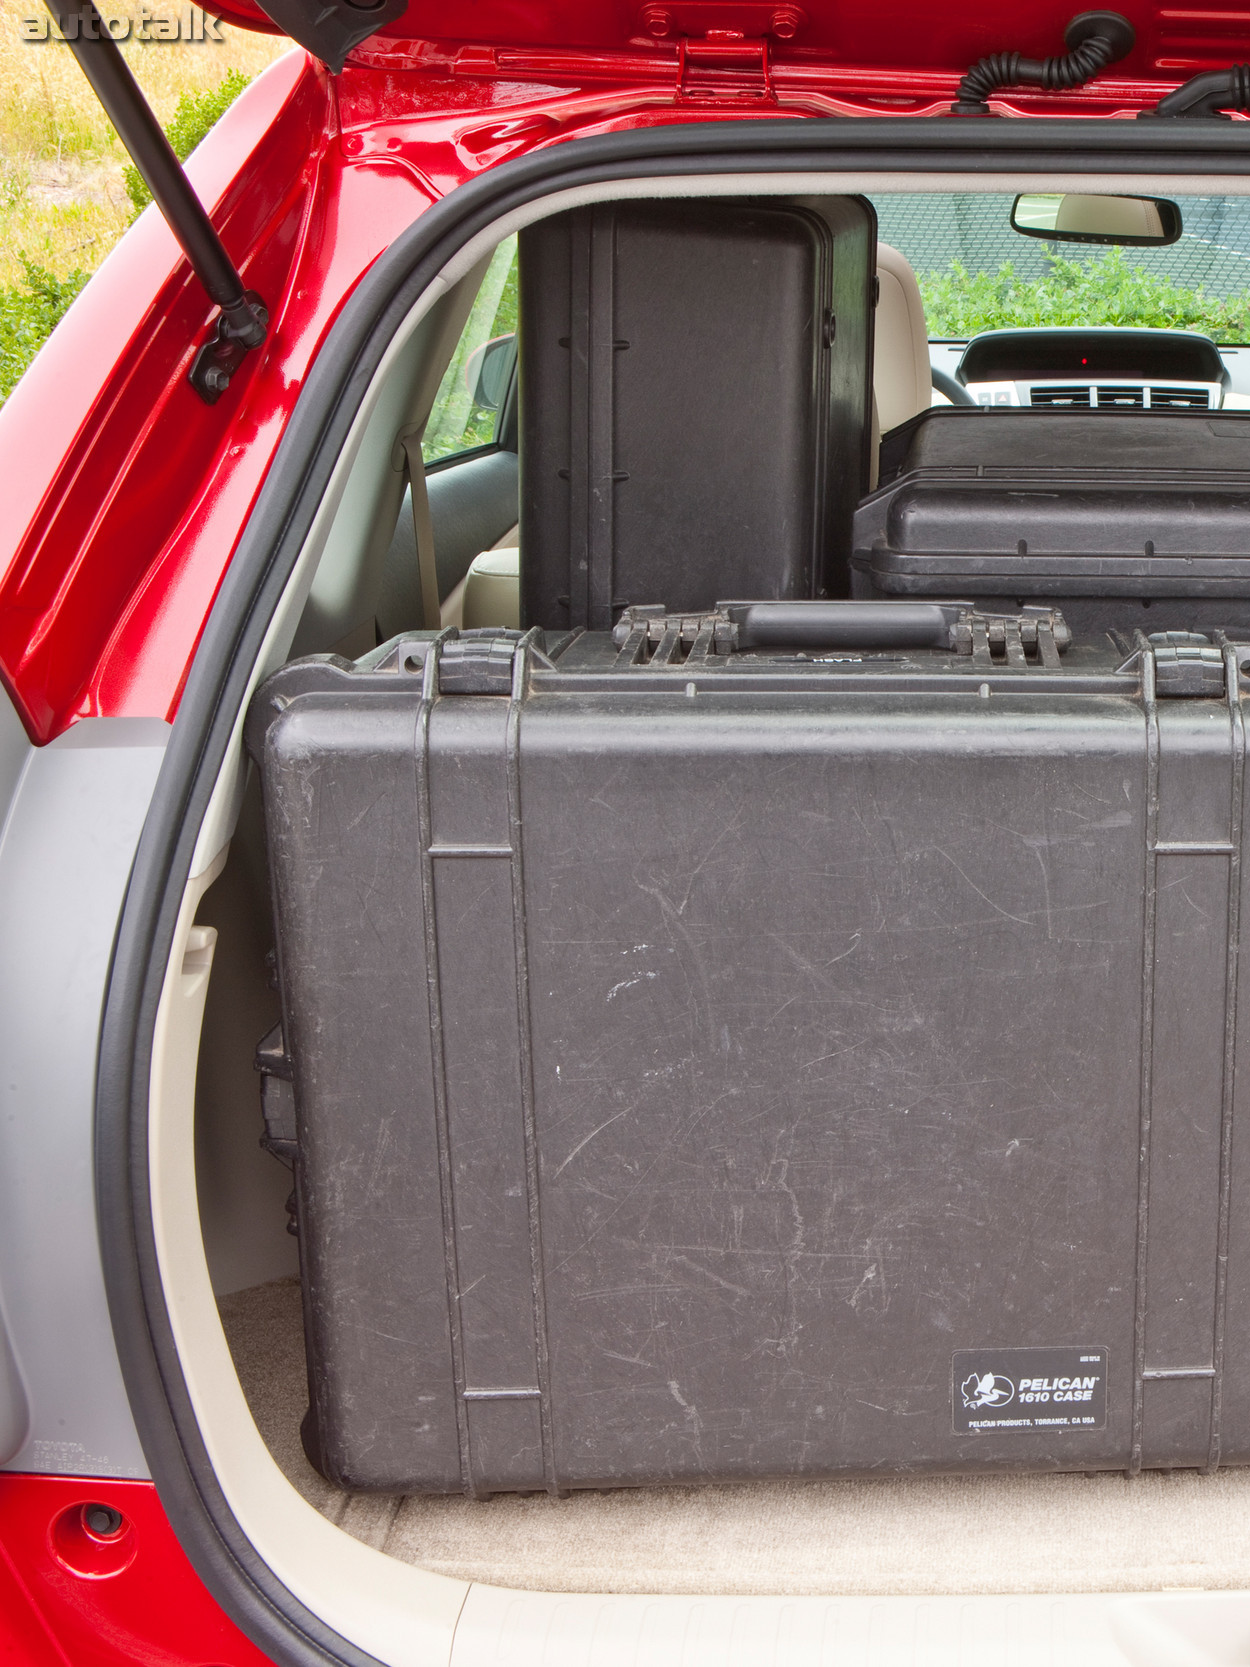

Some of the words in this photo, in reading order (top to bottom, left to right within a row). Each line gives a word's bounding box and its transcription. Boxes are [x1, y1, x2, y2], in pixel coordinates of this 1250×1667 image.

[1018, 1377, 1095, 1391] PELICAN
[1018, 1392, 1050, 1403] 1610
[1053, 1390, 1093, 1402] CASE
[968, 1419, 996, 1428] PELICAN
[997, 1418, 1033, 1427] PRODUCTS,
[1035, 1417, 1070, 1425] TORRANCE,
[33, 1440, 86, 1453] TOYOTA
[33, 1451, 74, 1461] STANLEY
